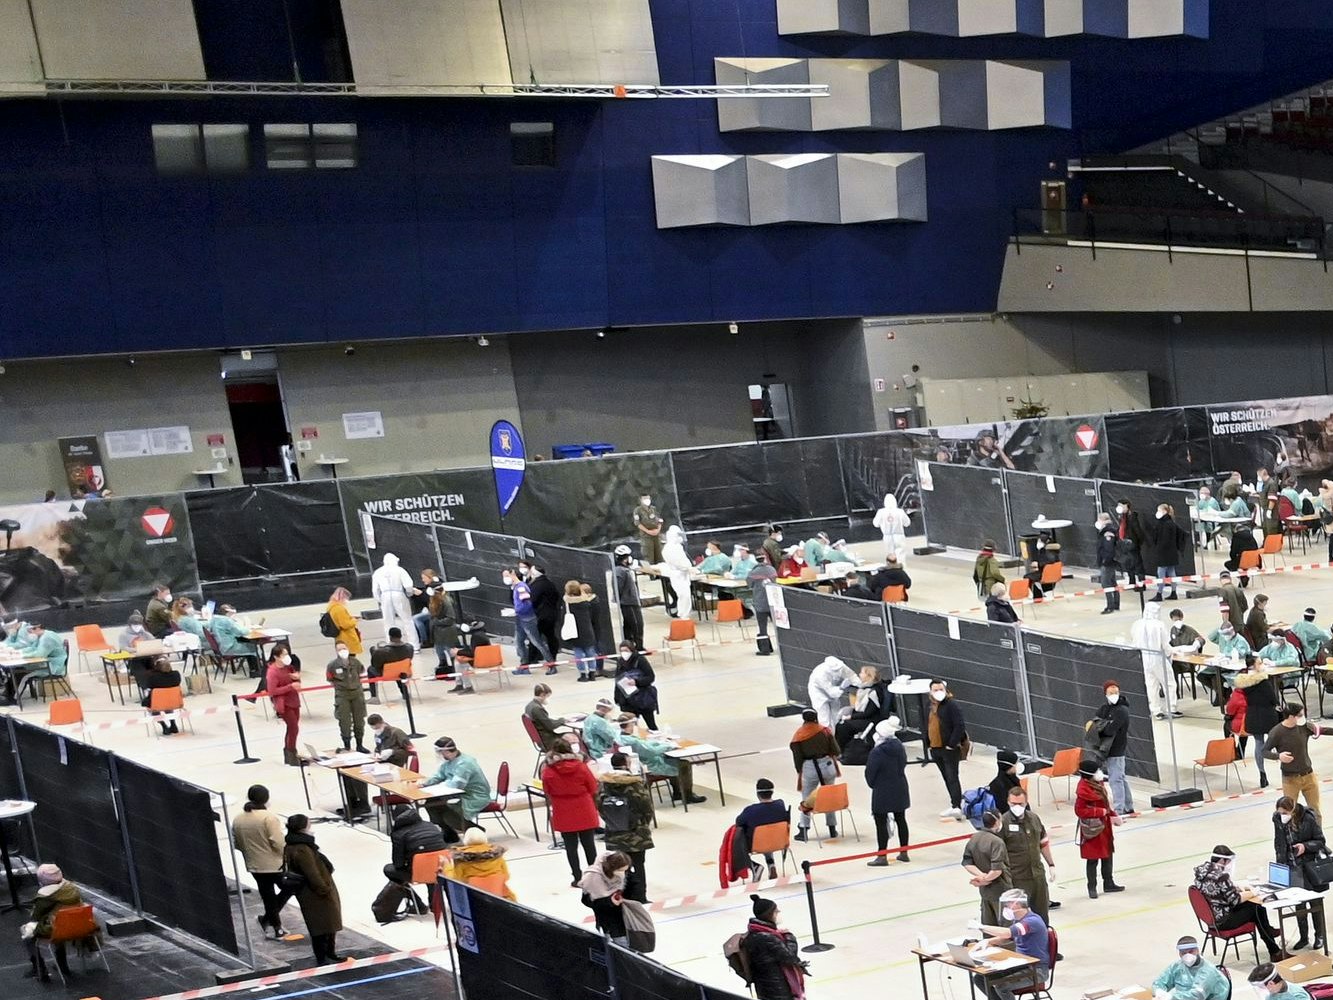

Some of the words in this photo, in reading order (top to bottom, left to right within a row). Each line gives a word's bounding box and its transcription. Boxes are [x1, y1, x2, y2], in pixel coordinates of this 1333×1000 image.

[1210, 411, 1230, 422] WIR
[363, 499, 393, 513] WIR
[395, 493, 465, 511] SCHÜTZEN
